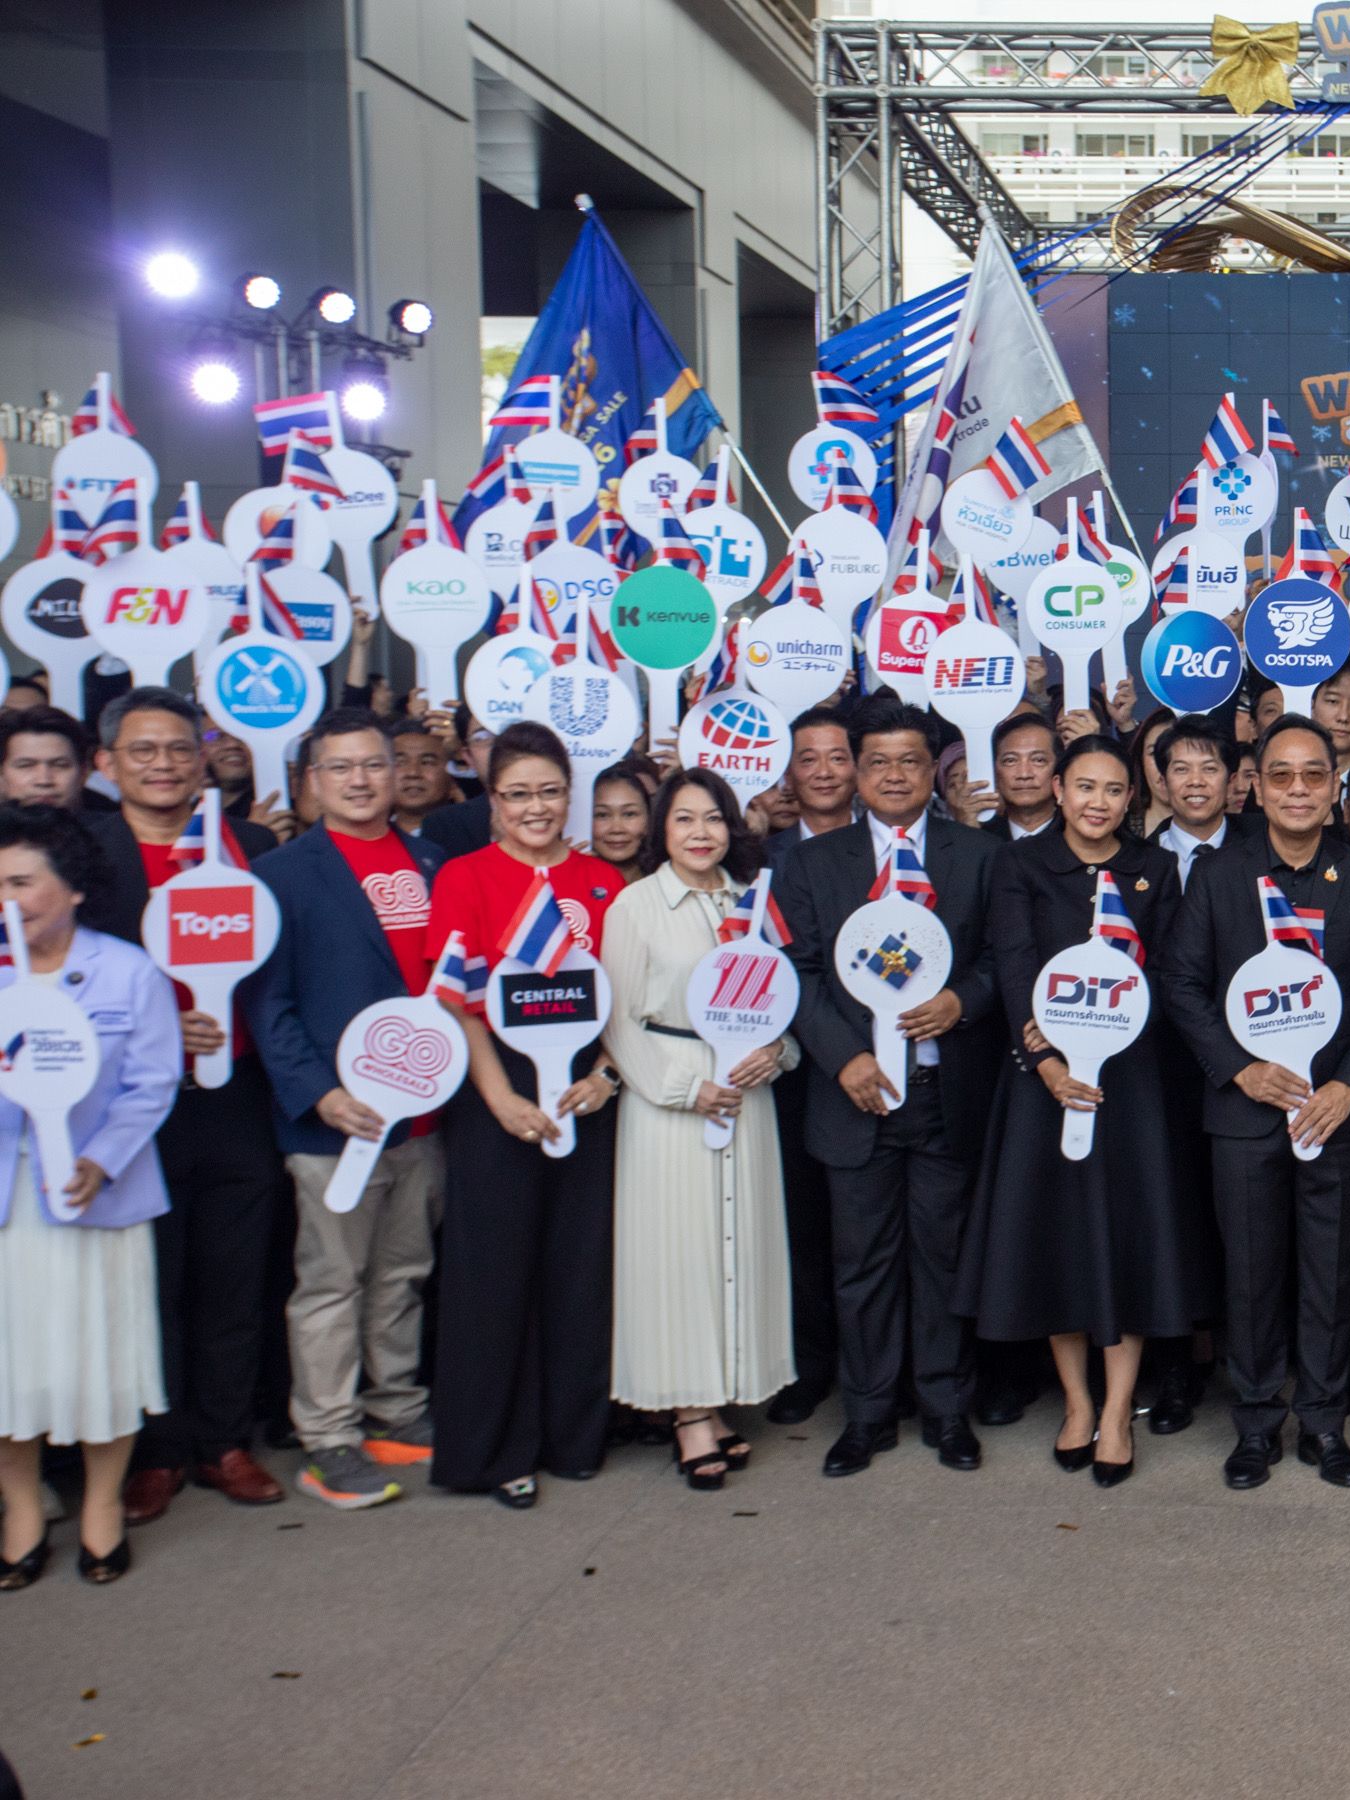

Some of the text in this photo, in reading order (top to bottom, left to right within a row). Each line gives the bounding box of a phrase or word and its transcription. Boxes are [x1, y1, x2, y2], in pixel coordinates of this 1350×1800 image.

[1218, 518, 1250, 526] GROUP
[564, 578, 614, 600] DSG
[105, 587, 189, 625] F&N
[1044, 585, 1105, 617] CP
[1045, 620, 1107, 631] CONSUMER
[777, 640, 843, 656] unicharm
[1161, 644, 1232, 679] P&G
[1265, 653, 1334, 667] OSOTSPA
[934, 656, 1014, 688] NEO
[698, 752, 771, 772] EARTH
[746, 773, 769, 786] Life
[172, 911, 252, 940] Tops
[510, 987, 587, 1004] CENTRAL
[522, 1002, 578, 1016] RETAIL
[704, 1010, 774, 1026] THE MALL
[1045, 1008, 1130, 1024] กรมการค้าภายใน
[1248, 1010, 1326, 1031] กรมการค้าภายใน
[361, 1062, 431, 1094] WHOLESALE
